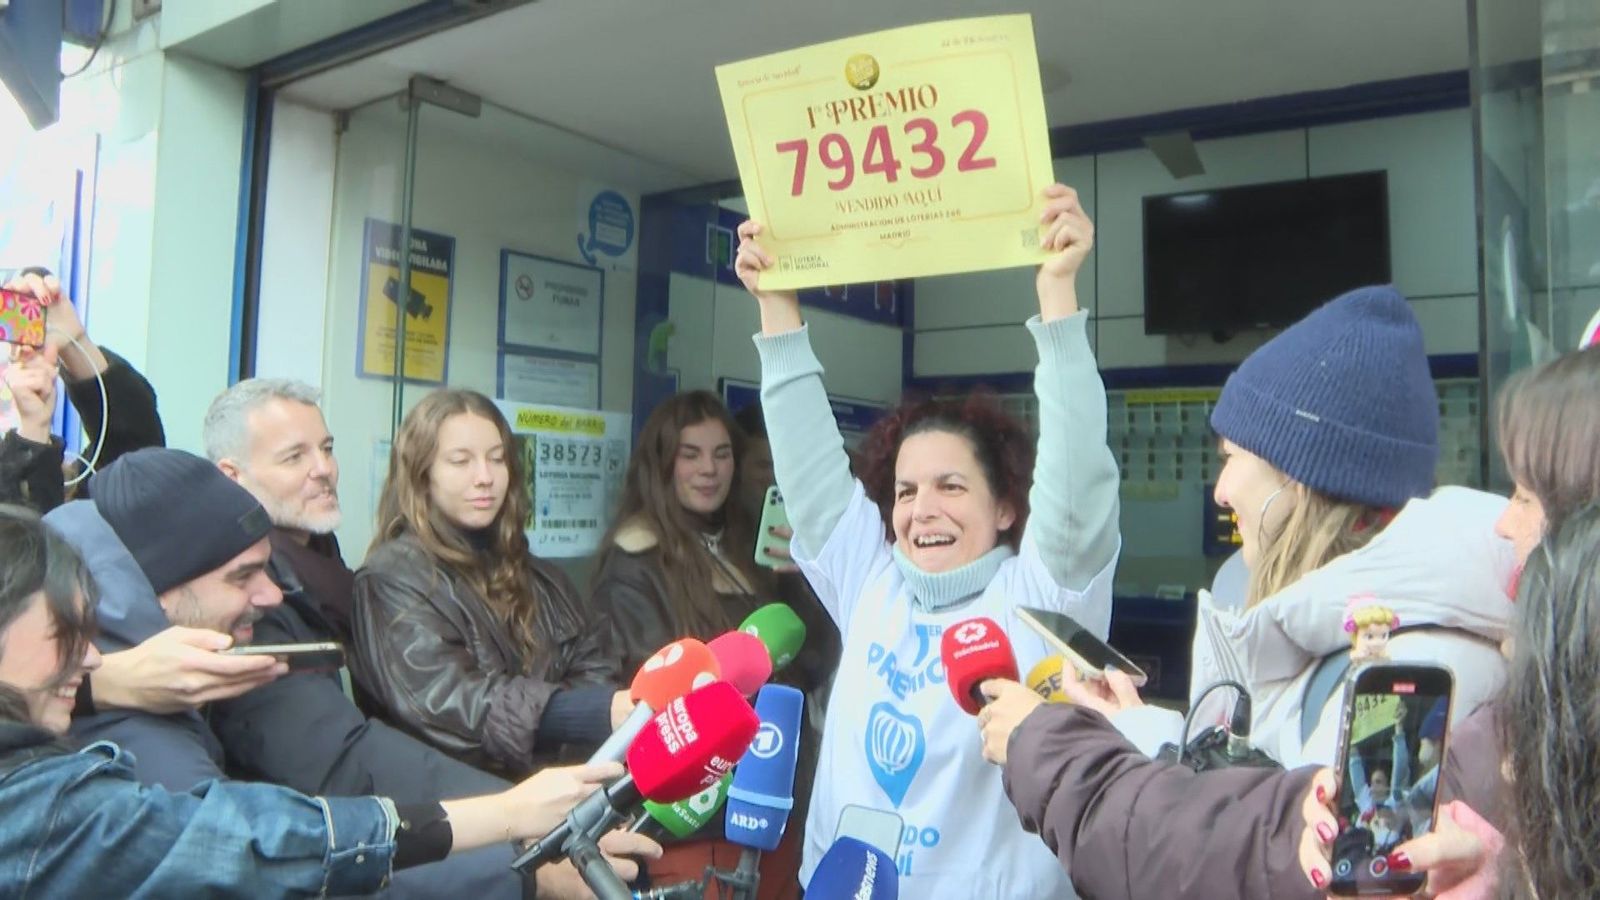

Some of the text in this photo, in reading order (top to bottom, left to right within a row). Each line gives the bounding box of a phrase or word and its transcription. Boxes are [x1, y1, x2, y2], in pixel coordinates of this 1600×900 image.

[825, 84, 938, 125] PREMIO
[776, 109, 997, 197] 79432
[835, 184, 943, 214] VENDIDO AQUÍ
[879, 228, 911, 241] MADRID
[540, 443, 602, 466] 38573
